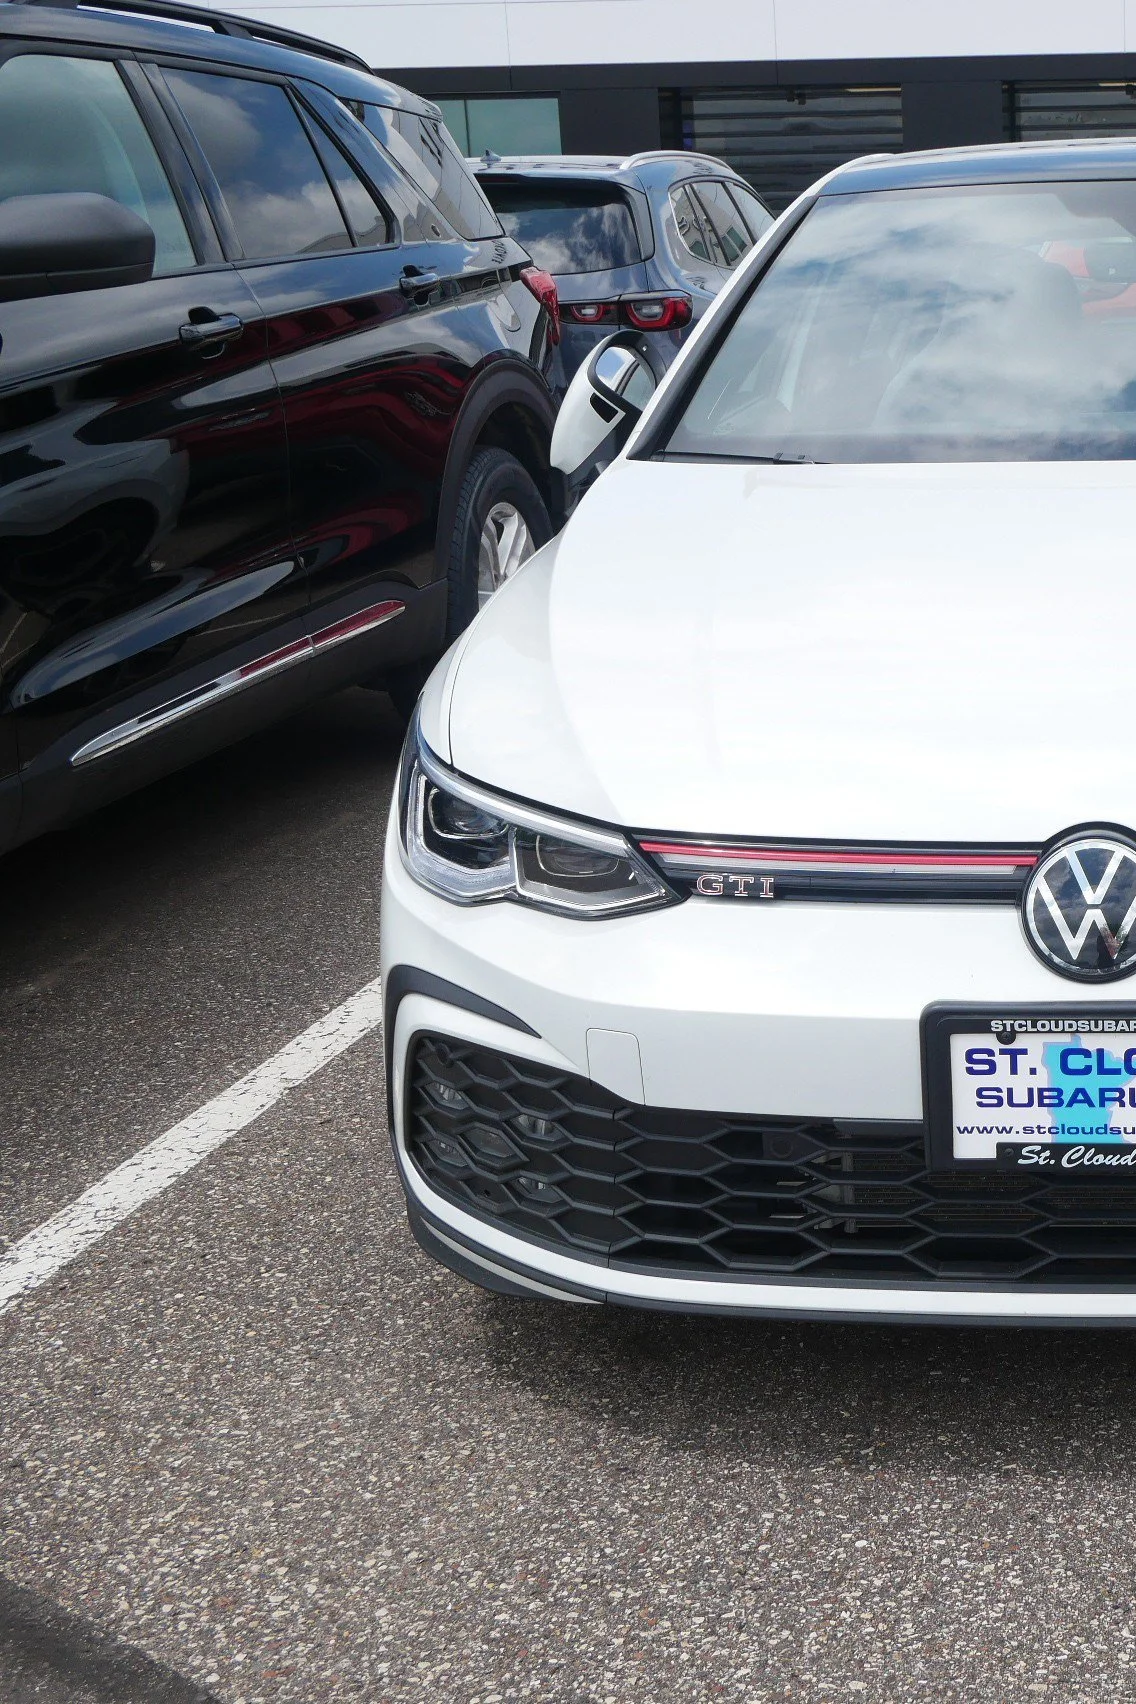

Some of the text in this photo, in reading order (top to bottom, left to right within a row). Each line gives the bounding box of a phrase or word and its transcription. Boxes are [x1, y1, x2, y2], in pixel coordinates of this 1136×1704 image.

[696, 874, 775, 898] GTI
[964, 1047, 1038, 1076] ST.
[1017, 1145, 1136, 1167] St. Cloud
